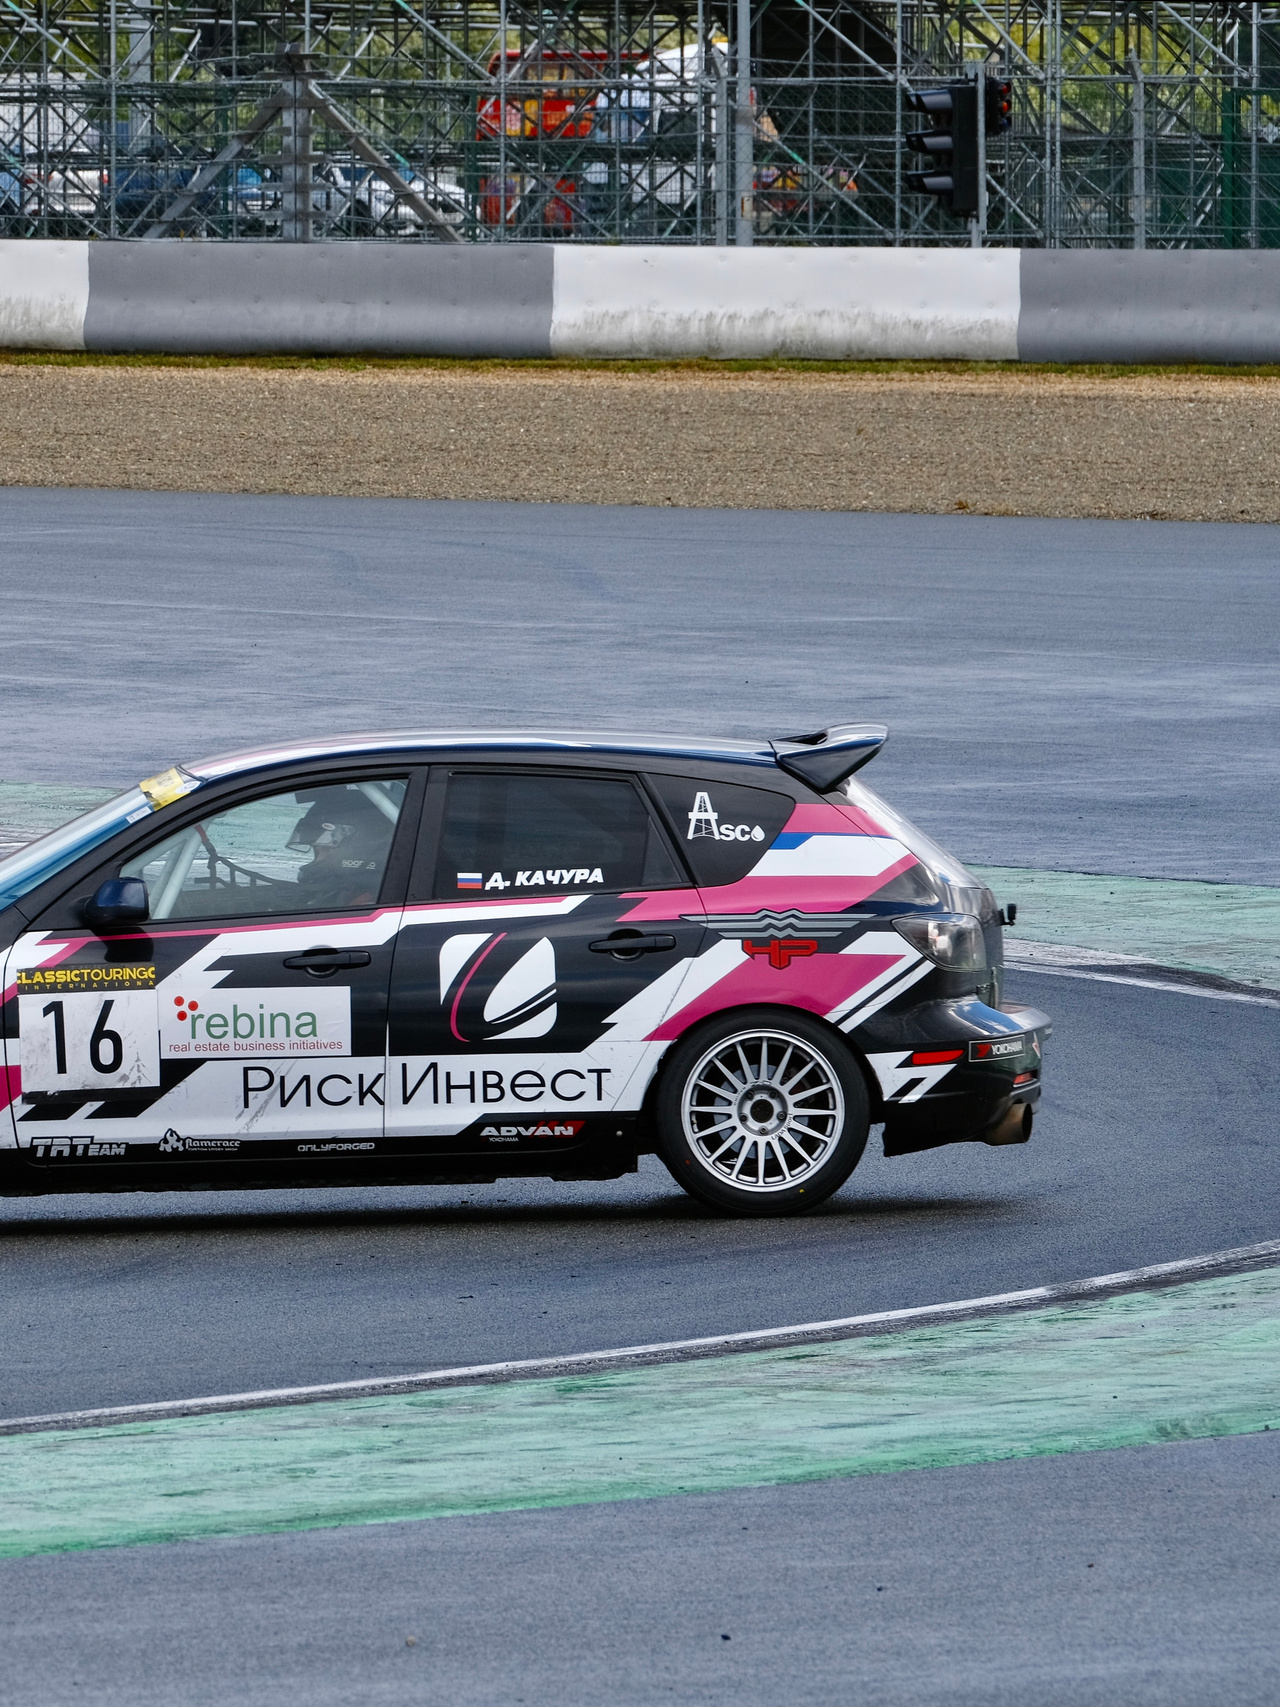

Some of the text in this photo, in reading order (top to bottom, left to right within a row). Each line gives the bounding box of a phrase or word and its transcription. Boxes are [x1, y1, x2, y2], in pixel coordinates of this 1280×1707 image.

[484, 868, 604, 890] Д. КАЧУРА
[190, 1003, 318, 1040] rebina
[42, 999, 123, 1075] 16
[170, 1039, 343, 1053] real estate business initiatives
[991, 1041, 1023, 1056] YOKOHAMA
[479, 1126, 574, 1136] ADVAN
